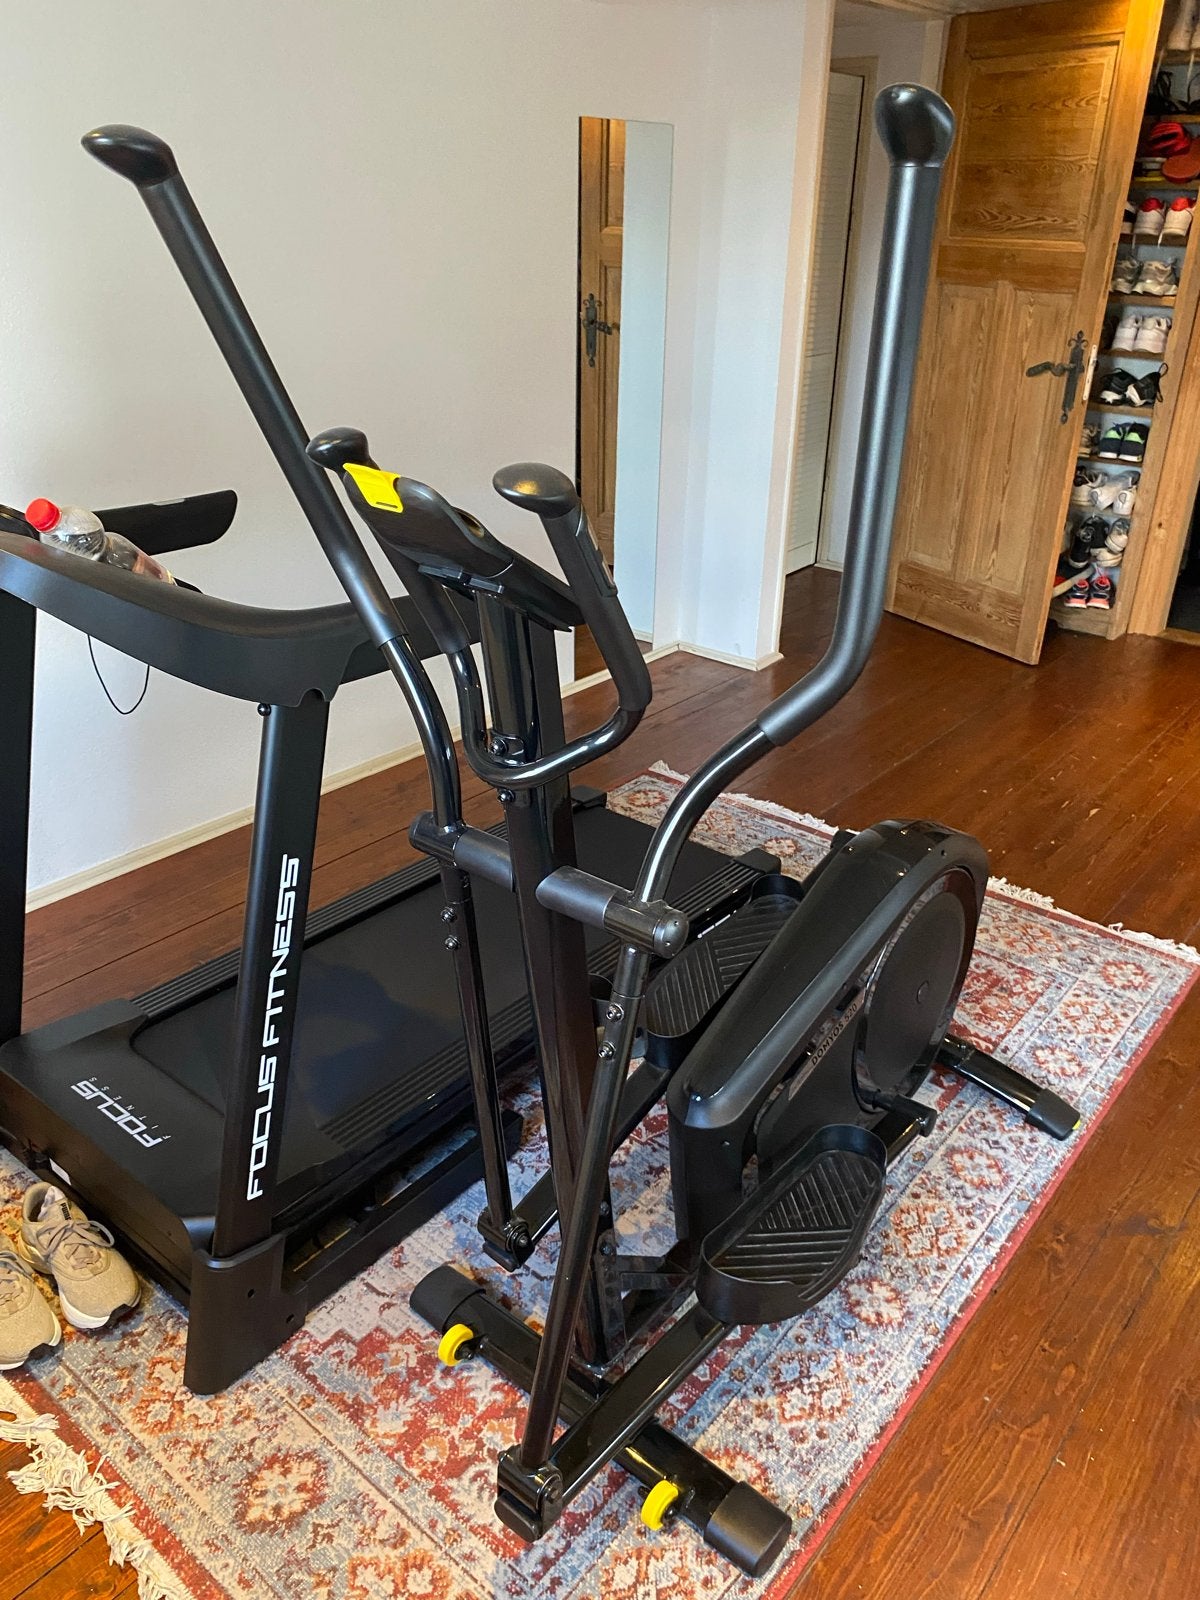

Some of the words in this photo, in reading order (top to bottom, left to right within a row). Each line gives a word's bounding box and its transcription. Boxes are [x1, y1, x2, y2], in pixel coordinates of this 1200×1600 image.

[246, 1054, 277, 1201] FOCUS
[262, 853, 300, 1048] FITNESS
[811, 1021, 844, 1066] DOMYOS
[70, 1080, 163, 1148] FOCUS
[88, 1076, 172, 1140] FITNESS
